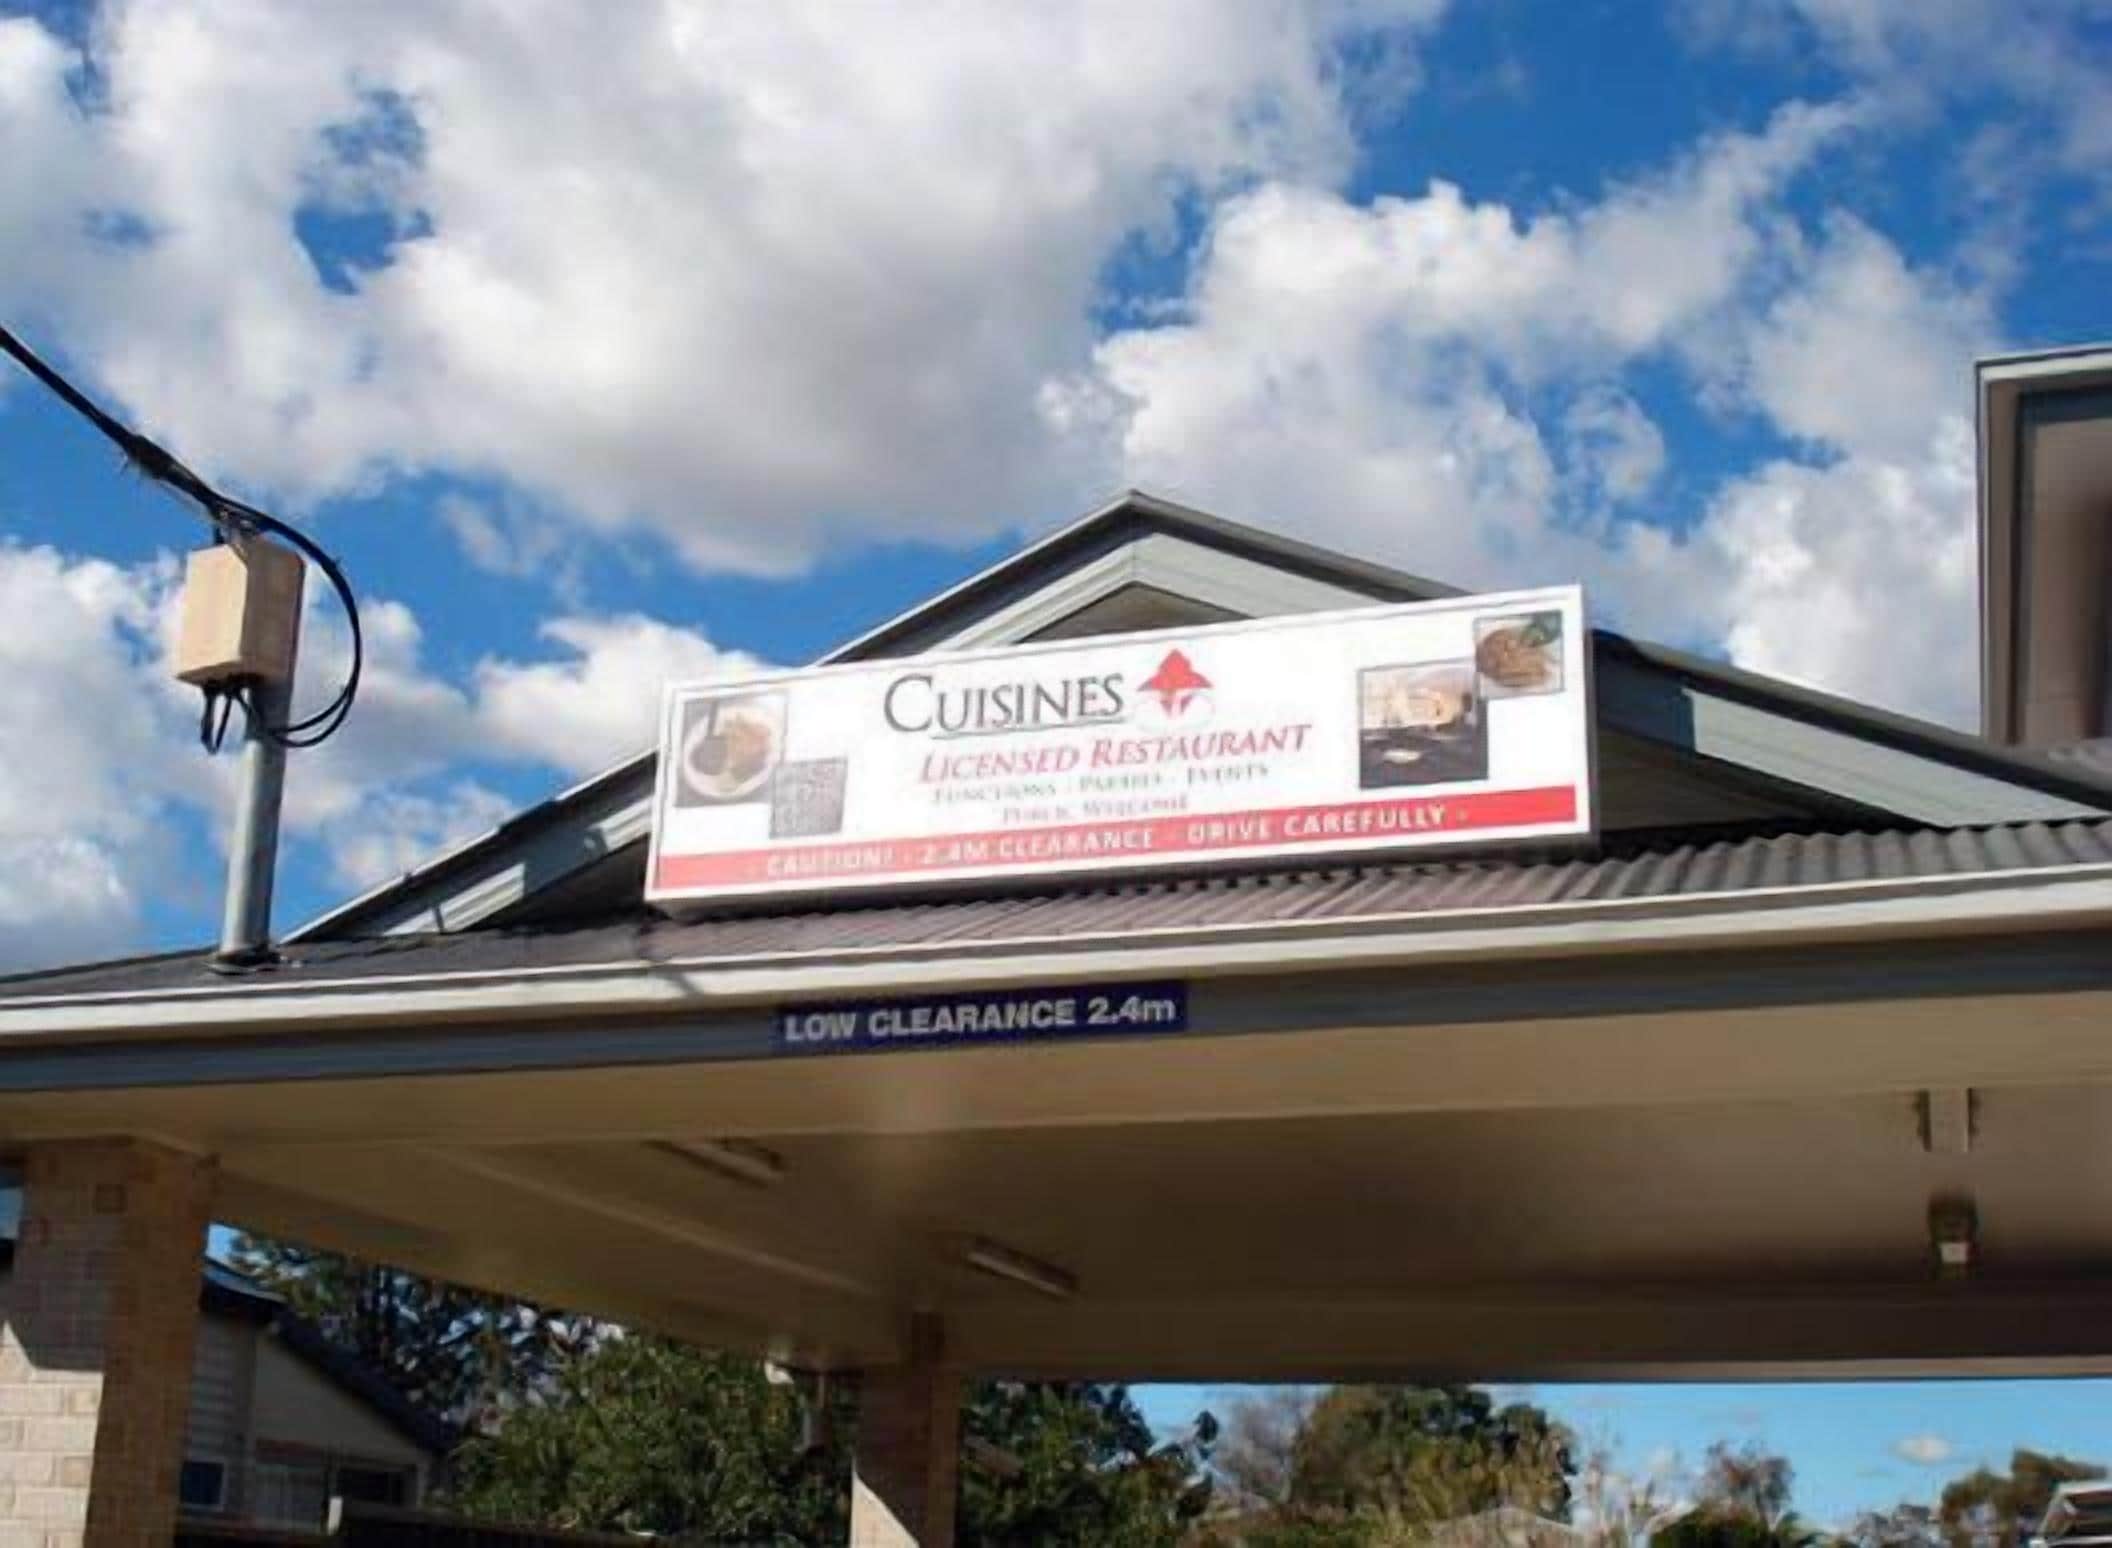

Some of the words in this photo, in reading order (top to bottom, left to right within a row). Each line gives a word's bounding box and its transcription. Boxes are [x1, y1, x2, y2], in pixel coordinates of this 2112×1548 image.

[884, 673, 1123, 732] CUISINES
[921, 747, 1080, 784] LICENSED
[1091, 724, 1312, 768] RESTAURANT
[999, 828, 1153, 859] CLEARANCE
[1187, 816, 1271, 844] DRIVE
[1284, 804, 1447, 836] CAREFULLY
[785, 1012, 857, 1041] LOW
[868, 999, 1076, 1035] CLEARANCE
[1087, 995, 1176, 1024] 2.4m
